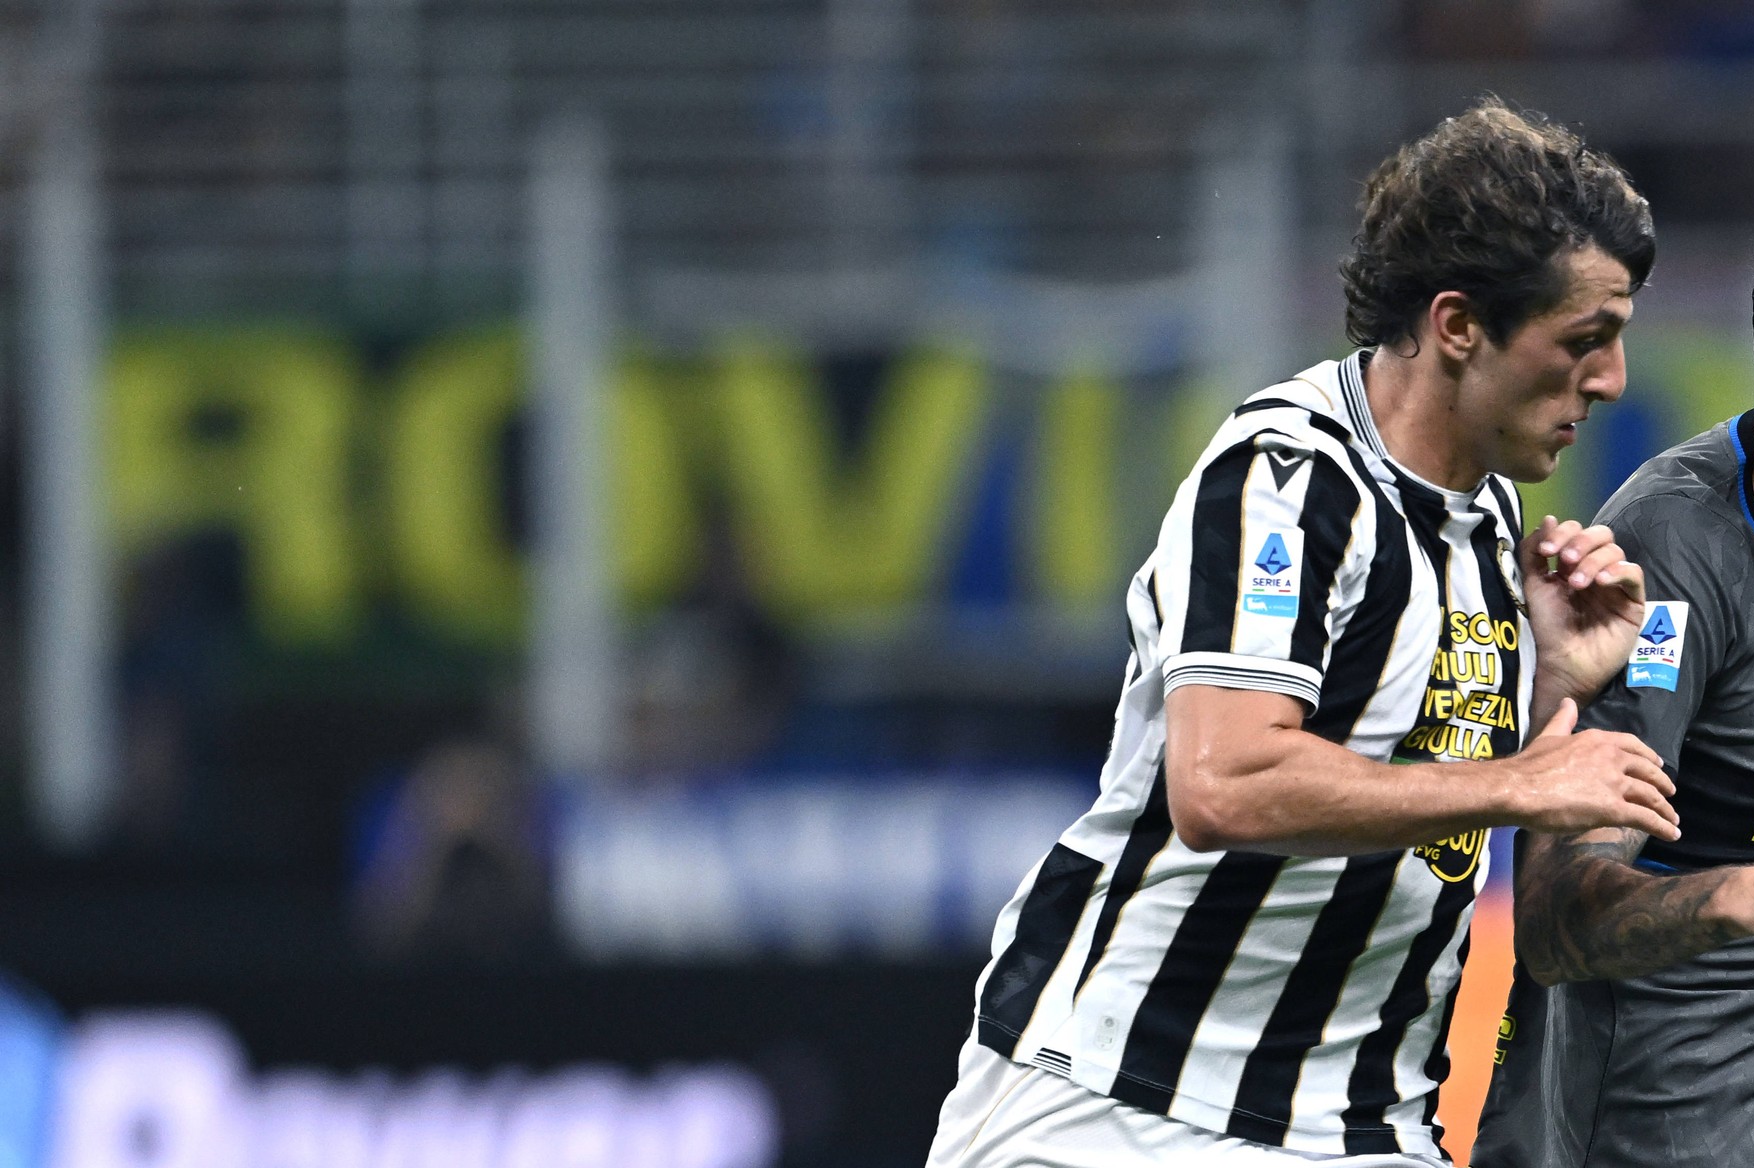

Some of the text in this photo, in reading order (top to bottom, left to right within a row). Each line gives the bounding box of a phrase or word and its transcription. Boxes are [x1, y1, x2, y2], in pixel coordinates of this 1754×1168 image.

[1252, 577, 1292, 587] SERIE A
[1450, 612, 1518, 650] SONO
[1431, 648, 1495, 685] RIULI
[1637, 647, 1675, 657] SERIE A
[1424, 686, 1516, 732] VENEZIA
[1403, 726, 1494, 761] GIULIA
